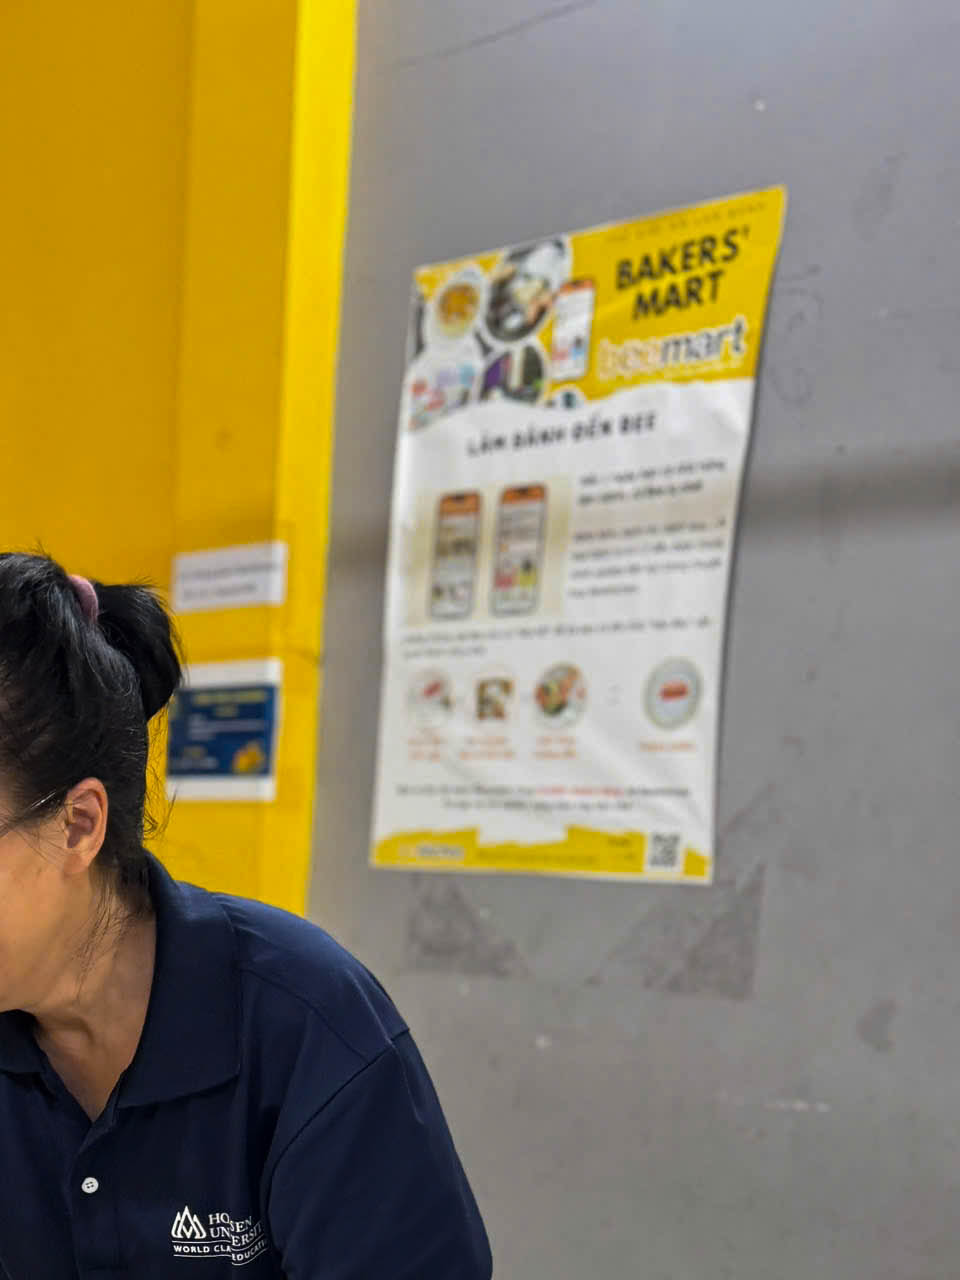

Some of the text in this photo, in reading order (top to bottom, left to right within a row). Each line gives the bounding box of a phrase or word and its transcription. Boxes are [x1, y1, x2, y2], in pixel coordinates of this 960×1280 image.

[617, 225, 750, 291] BAKERS'
[632, 270, 724, 322] MART
[620, 412, 657, 435] BEE
[208, 1213, 230, 1225] HO
[173, 1245, 210, 1253] WORLD
[214, 1245, 231, 1253] CLA
